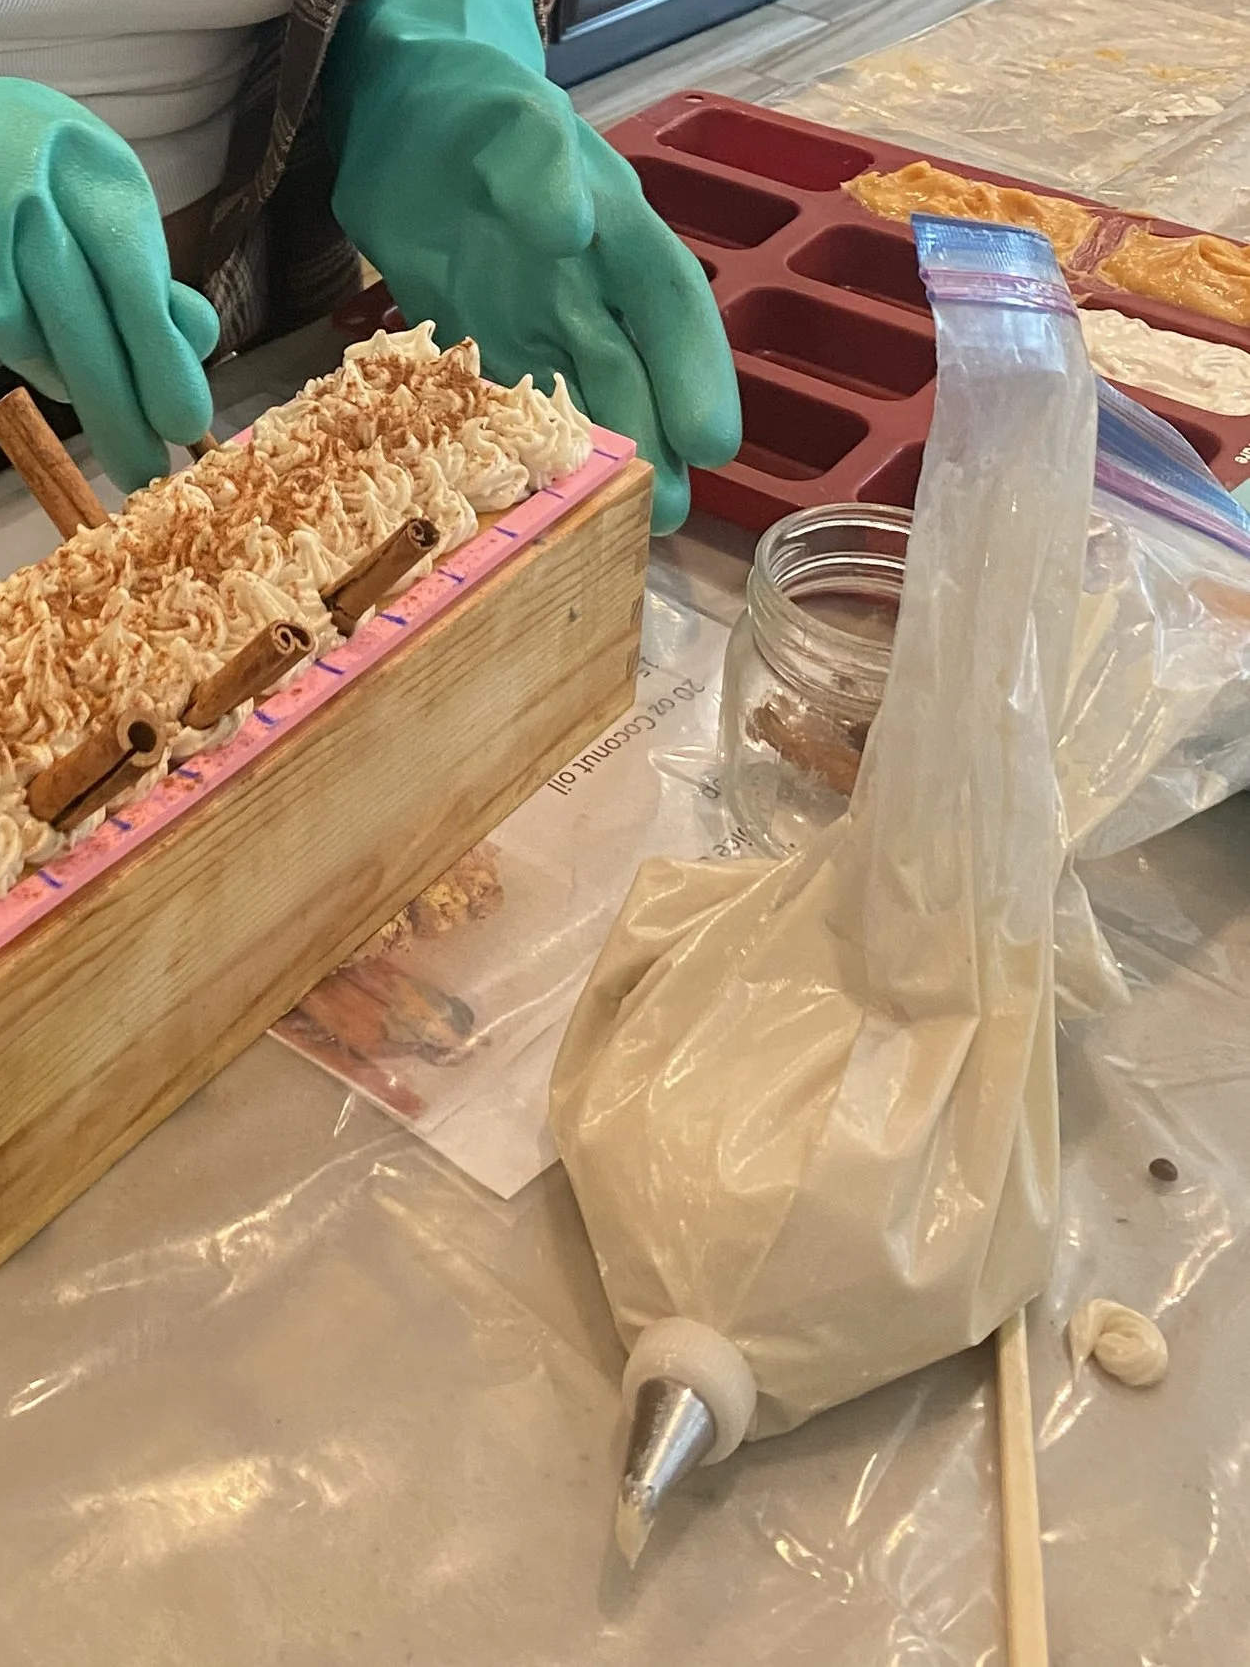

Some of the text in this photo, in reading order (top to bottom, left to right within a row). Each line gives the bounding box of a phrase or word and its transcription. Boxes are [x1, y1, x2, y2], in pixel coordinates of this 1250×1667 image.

[547, 678, 705, 796] 20 oz Coconut oil
